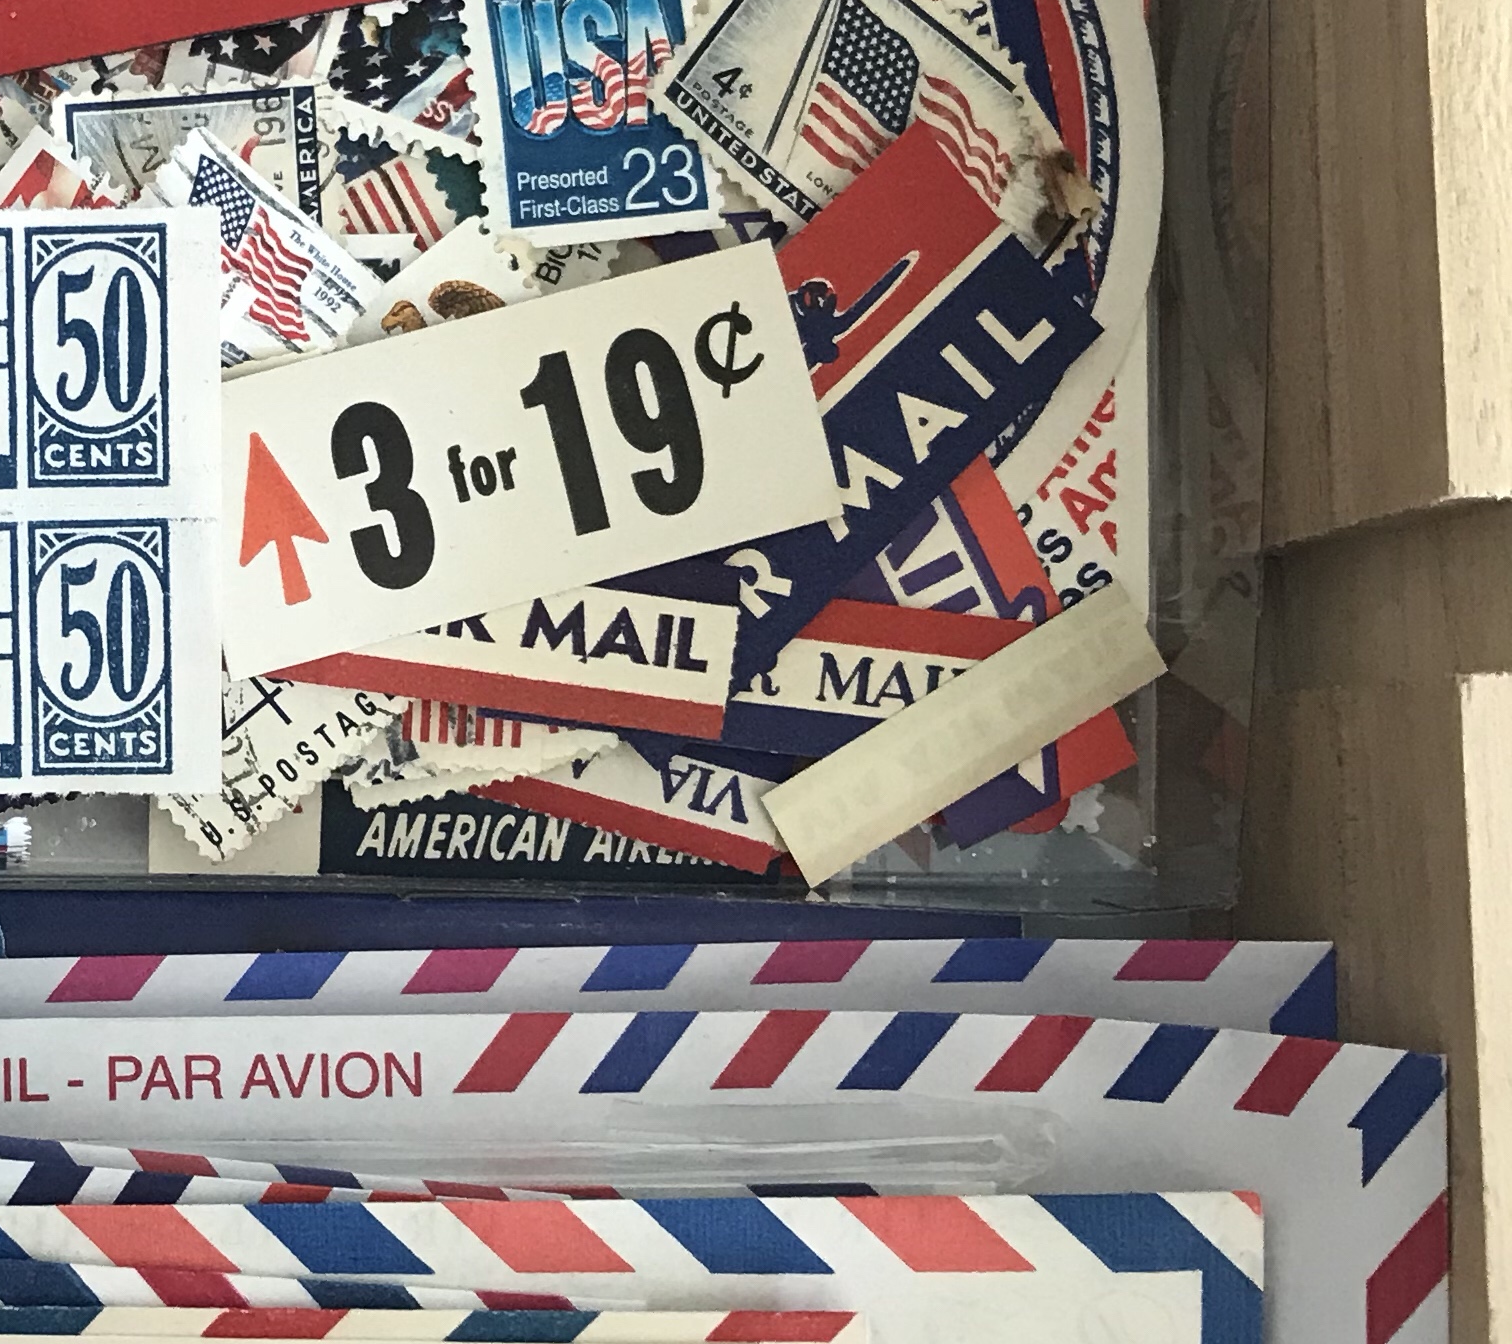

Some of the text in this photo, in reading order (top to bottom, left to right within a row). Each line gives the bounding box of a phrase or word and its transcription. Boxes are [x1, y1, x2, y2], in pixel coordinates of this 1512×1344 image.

[693, 82, 755, 139] POSTAGE
[712, 67, 753, 100] 4¢
[296, 95, 320, 226] AMERICA
[516, 166, 609, 192] Presorted
[624, 145, 700, 210] 23
[676, 90, 816, 216] UNITED STAT
[519, 195, 620, 220] First-Class
[289, 229, 357, 292] The White House
[314, 286, 341, 314] 1992
[55, 264, 148, 413] 50
[44, 443, 154, 472] CENTS
[330, 301, 764, 591] 3 for 19¢
[59, 558, 152, 702] 50
[521, 596, 709, 673] MAIL
[816, 652, 971, 709] MAI
[49, 730, 157, 758] CENTS
[257, 688, 379, 796] POSTAG
[659, 755, 750, 825] VIA
[357, 812, 570, 862] AMERICAN
[107, 1053, 224, 1101] PAR
[240, 1051, 425, 1100] AVION
